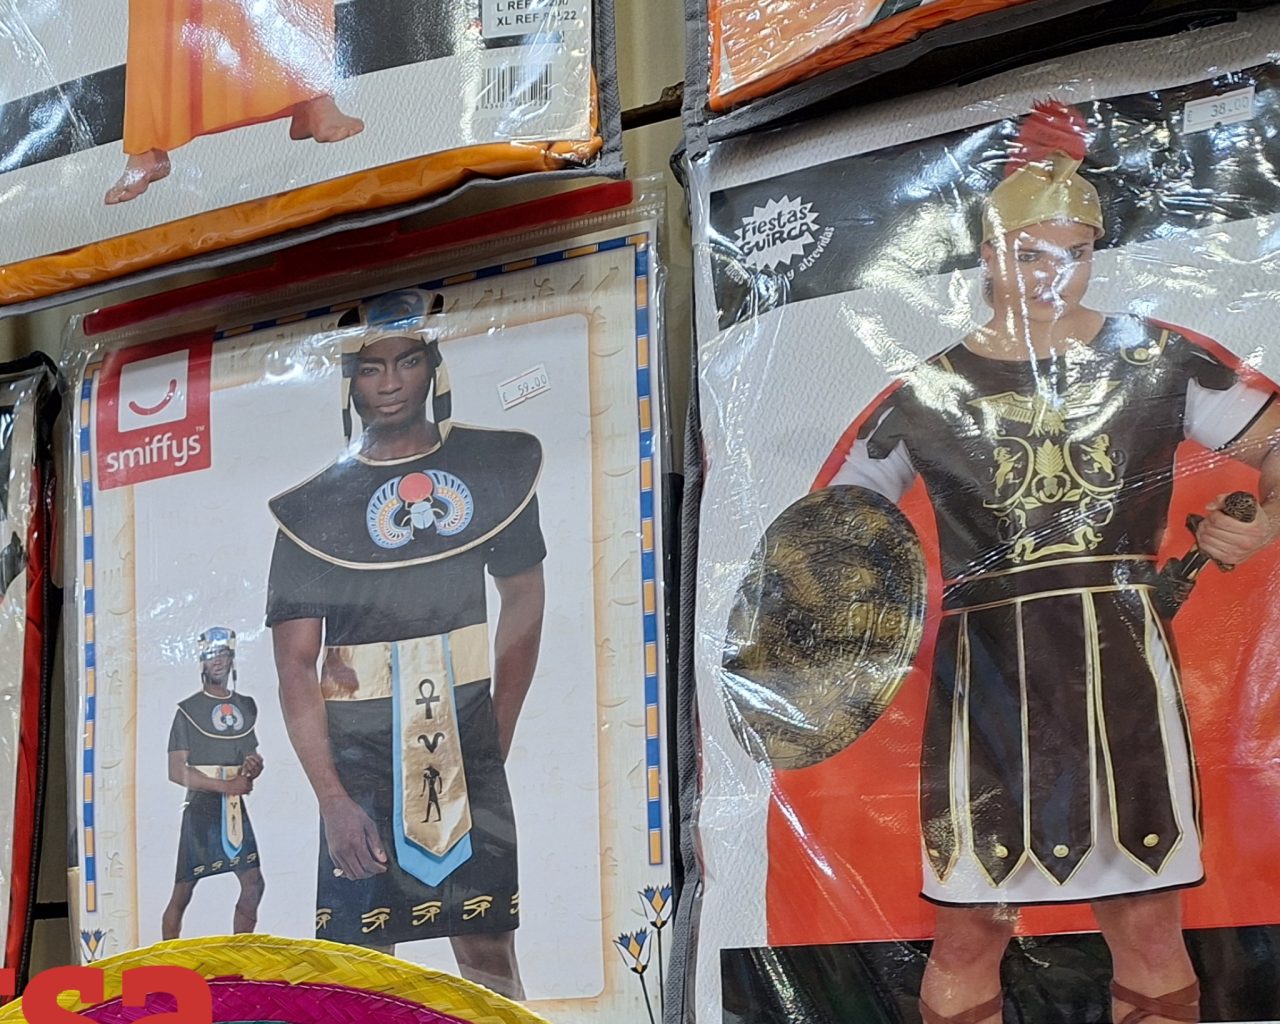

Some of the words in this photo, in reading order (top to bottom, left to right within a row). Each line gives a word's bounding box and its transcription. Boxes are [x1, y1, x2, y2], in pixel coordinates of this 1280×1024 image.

[497, 16, 512, 26] XL
[742, 206, 808, 241] Fiestas
[799, 226, 835, 272] atrevidas
[517, 374, 547, 397] 59.00
[106, 431, 201, 473] smiffys
